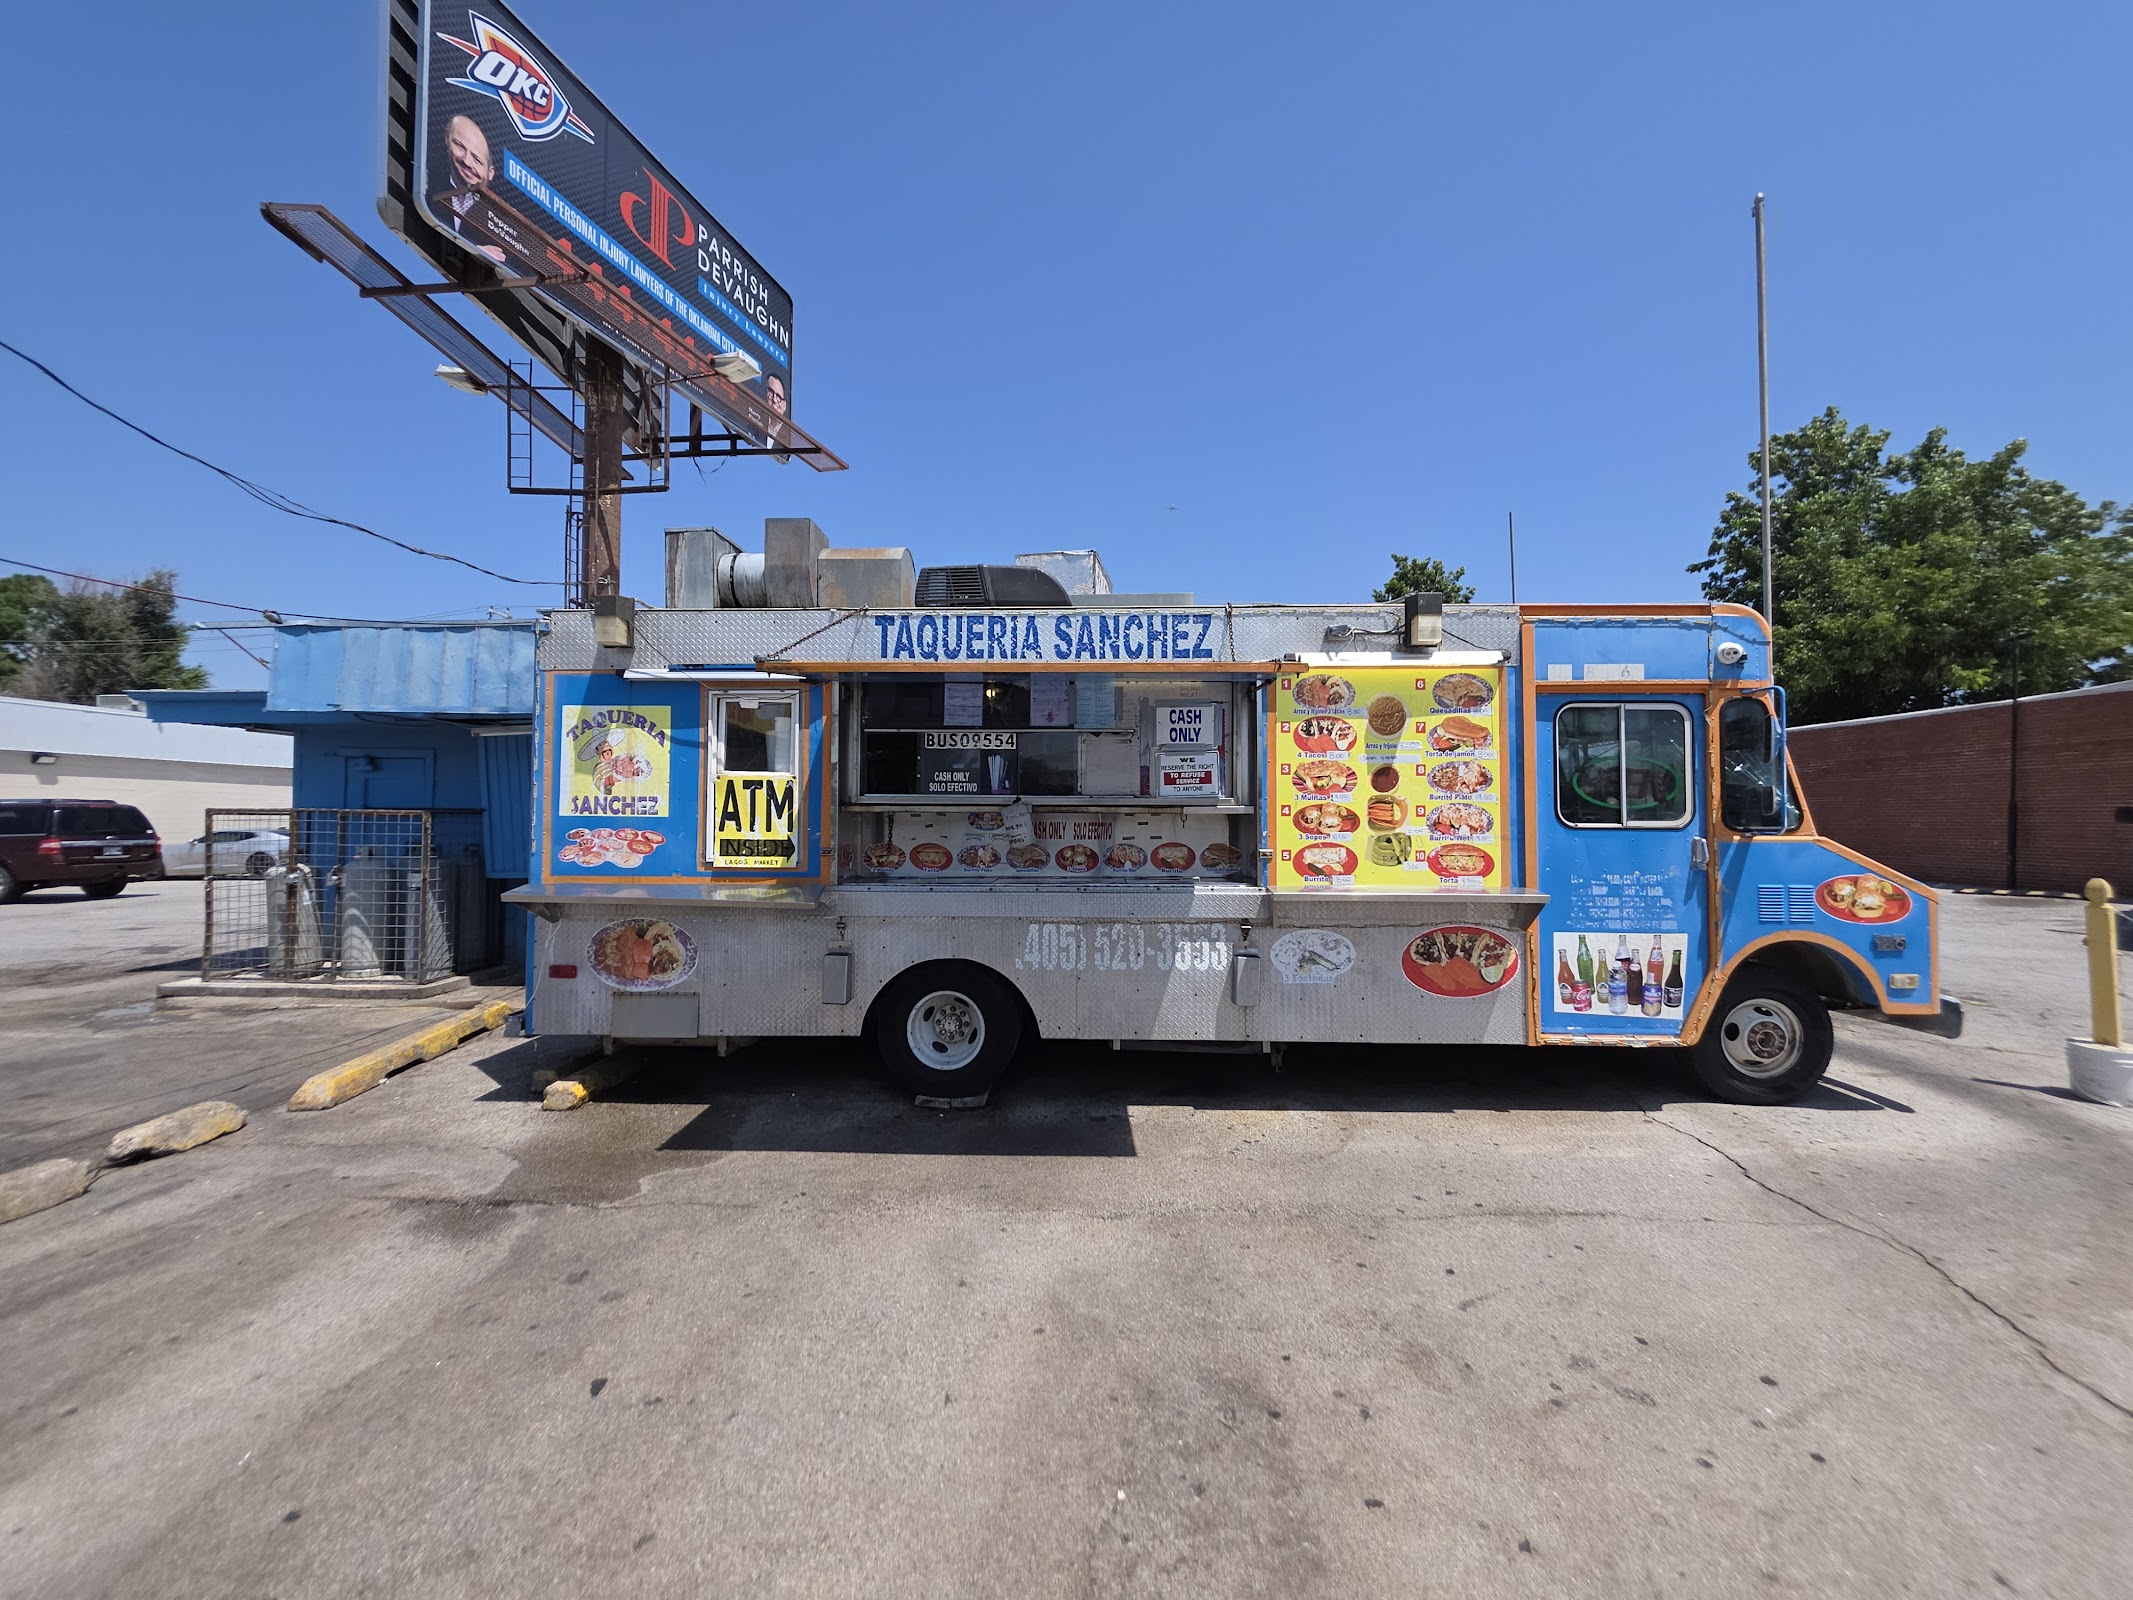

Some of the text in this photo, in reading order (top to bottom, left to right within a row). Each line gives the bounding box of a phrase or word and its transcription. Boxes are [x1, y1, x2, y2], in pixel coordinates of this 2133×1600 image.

[473, 51, 551, 107] OKC
[509, 159, 552, 209] OFFICIAL
[553, 196, 598, 246] PERSONAL
[600, 234, 629, 271] INJURY
[630, 260, 664, 299] LAWYERS
[665, 289, 674, 306] OF
[675, 294, 688, 319] THE
[688, 308, 721, 346] OKLAHOMA
[721, 335, 738, 353] CITY
[698, 223, 768, 305] PARRISH
[698, 248, 789, 348] DEVAUGHN
[703, 283, 740, 322] Injury
[745, 321, 785, 363] Lawyers
[874, 614, 1213, 662] TAQUERIA SANCHEZ
[1282, 680, 1288, 688] 1
[1416, 680, 1424, 688] 6
[1169, 709, 1202, 725] CASH
[567, 709, 666, 748] TAQUERIA
[1282, 723, 1289, 731] 2
[1416, 722, 1424, 731] 7
[1169, 727, 1202, 743] ONLY
[934, 771, 970, 781] CASH ONLY
[1417, 765, 1425, 774] 8
[929, 782, 978, 792] SOLO EFECTIVO
[571, 795, 659, 815] SANCHEZ
[718, 779, 794, 833] ATM
[1282, 806, 1289, 814] 4
[1417, 806, 1424, 815] 9
[1049, 821, 1067, 840] ONLY
[1073, 821, 1087, 840] SOLO
[1087, 821, 1113, 840] EFECTIVO
[1282, 851, 1289, 860] 5
[1416, 851, 1424, 860] 10
